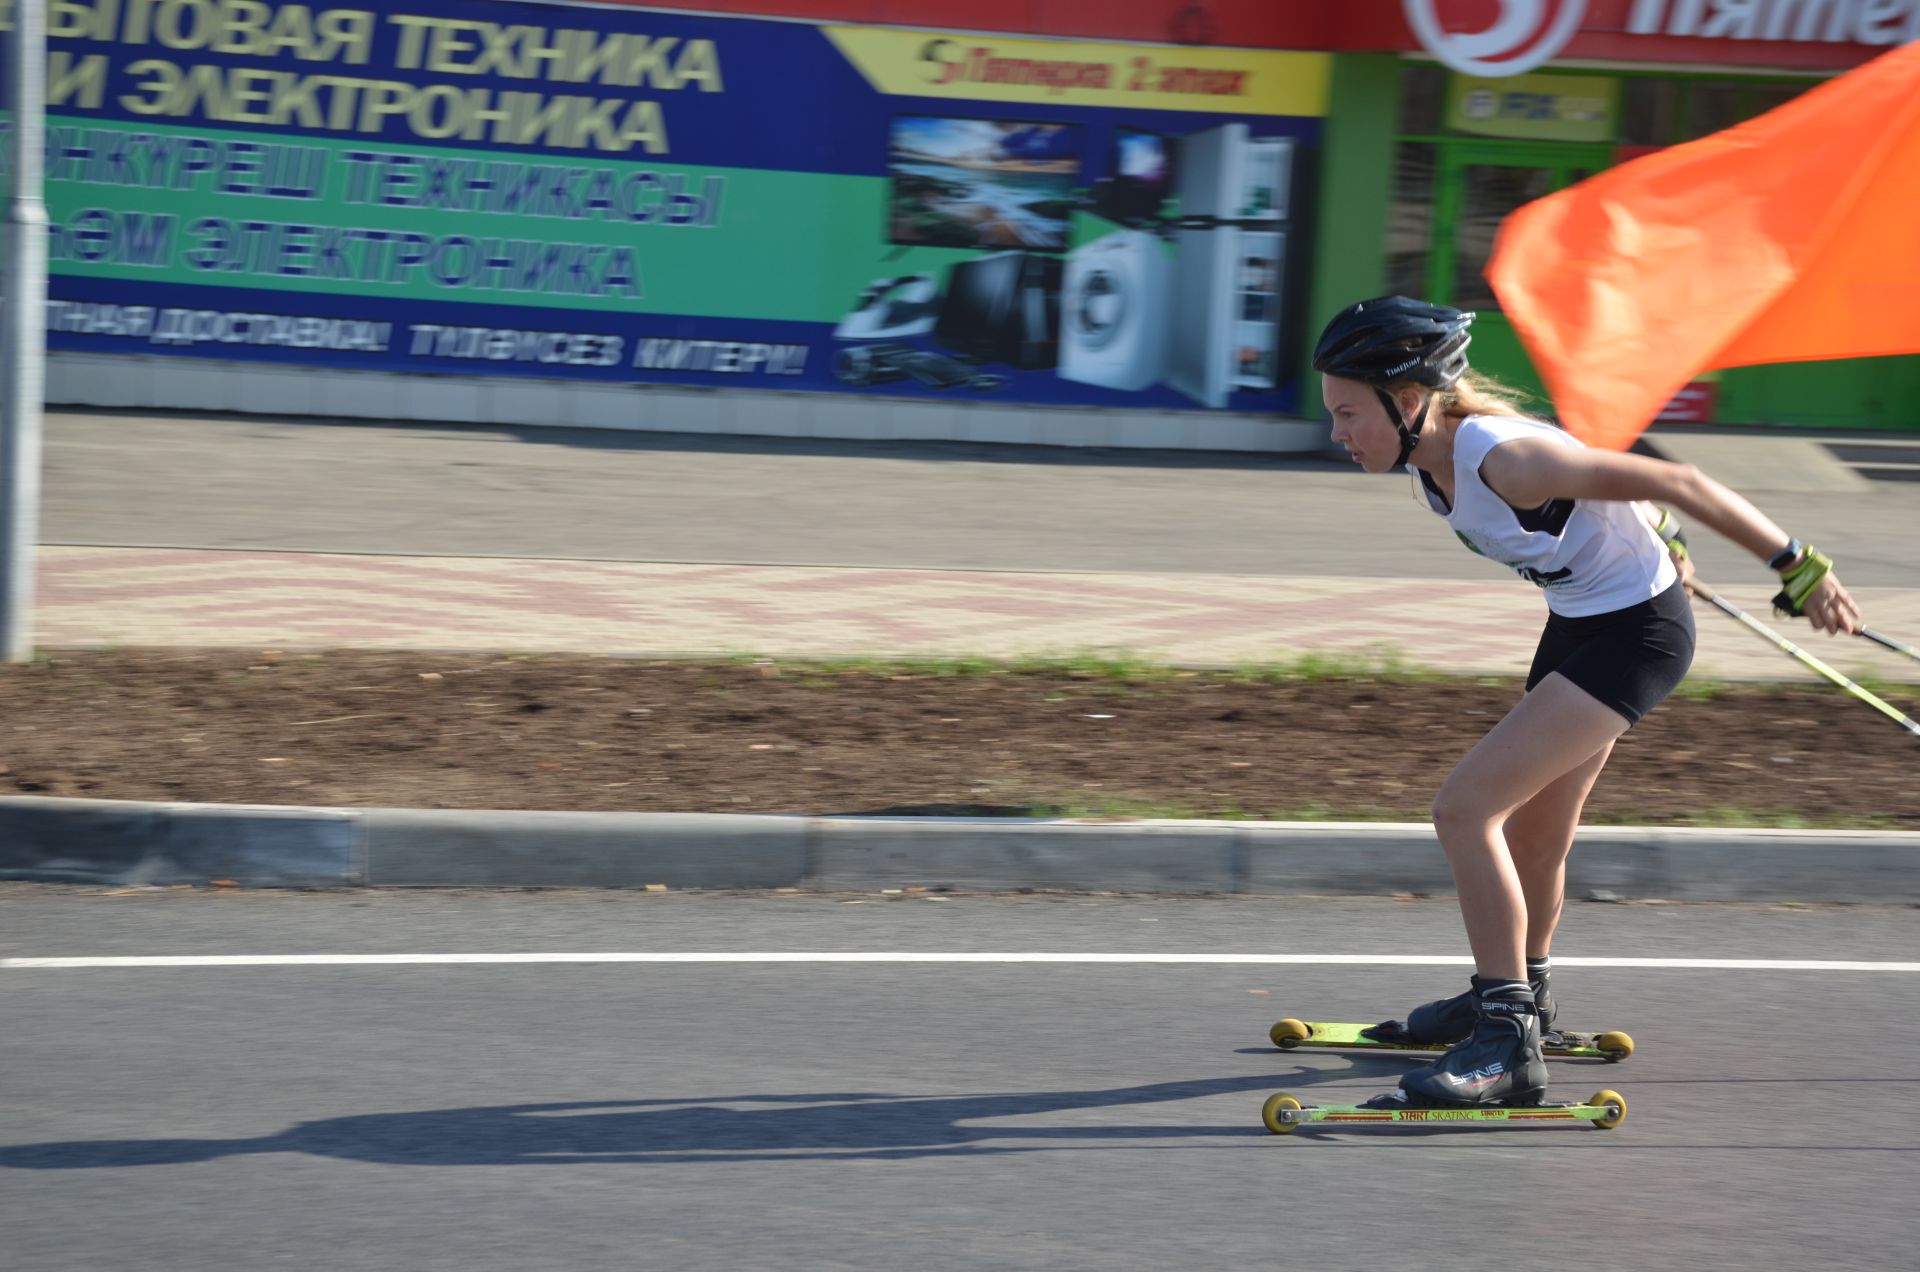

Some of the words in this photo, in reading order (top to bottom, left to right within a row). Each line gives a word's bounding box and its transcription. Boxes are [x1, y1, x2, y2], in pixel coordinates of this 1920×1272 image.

[0, 0, 376, 65] ЫТОВАЯ
[386, 14, 725, 93] ТЕХНИКА
[45, 50, 110, 109] И
[117, 59, 671, 154] ЭЛЕКТРОНИКА
[336, 149, 728, 228] ТЕХНИКАСЫ
[181, 216, 645, 299] ЭЛЕКТРОНИКА
[149, 308, 392, 352] ДОСТАВКА!
[1481, 1002, 1525, 1011] SPINE
[1449, 1062, 1504, 1086] SPINE
[1399, 1110, 1429, 1120] START
[1431, 1111, 1474, 1120] SKATING
